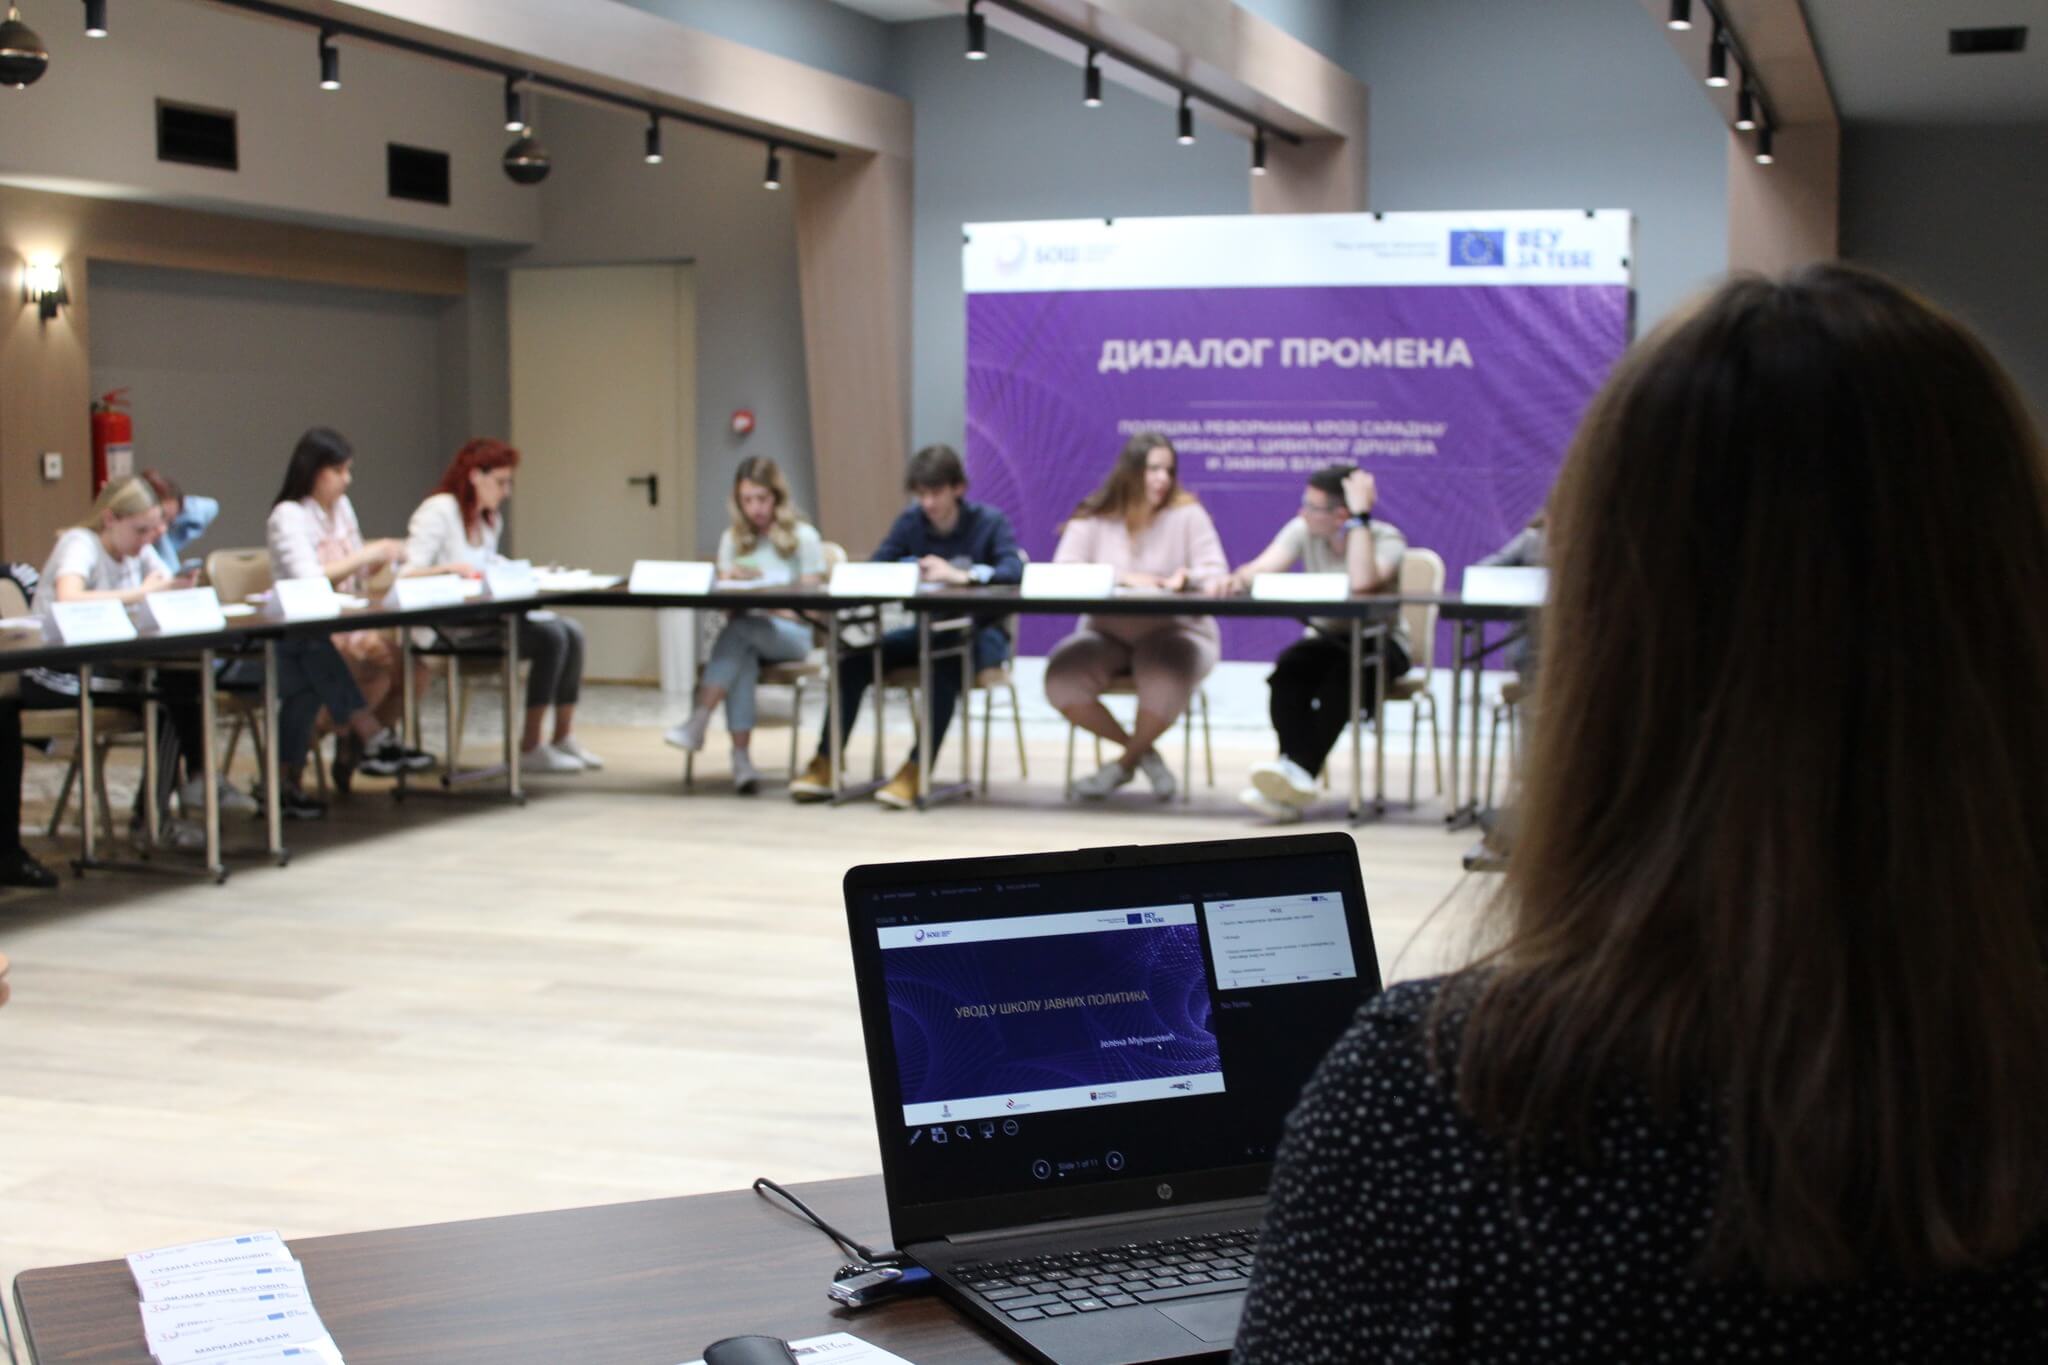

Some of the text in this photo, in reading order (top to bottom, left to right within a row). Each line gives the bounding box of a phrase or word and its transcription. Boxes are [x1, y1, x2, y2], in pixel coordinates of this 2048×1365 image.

[1098, 338, 1473, 373] ДИЈАЛОГ ПРОМЕНА
[954, 990, 1150, 1019] УВОД У ШКОЛУ ЈАВНИХ ПОЛИТИКА
